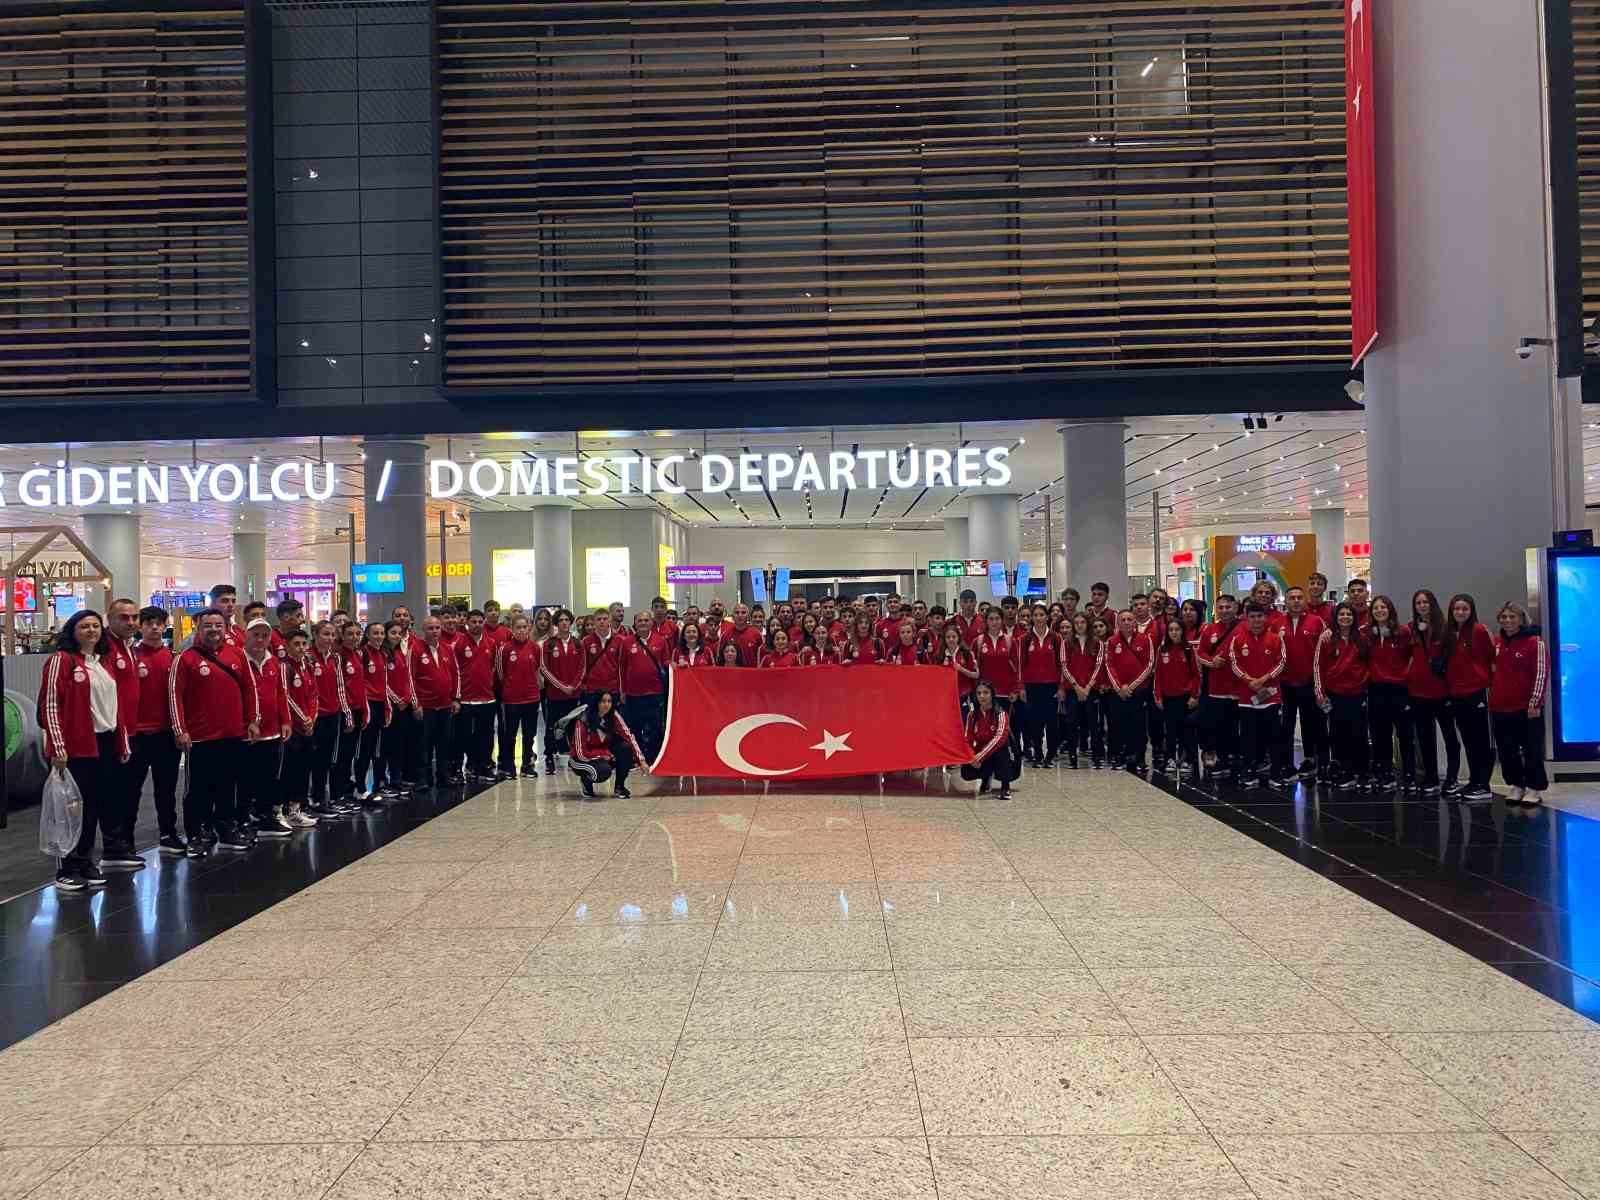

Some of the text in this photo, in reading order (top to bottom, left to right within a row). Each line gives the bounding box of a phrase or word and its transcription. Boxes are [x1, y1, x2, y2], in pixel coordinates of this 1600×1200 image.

[18, 460, 169, 506] GİDEN
[178, 462, 334, 502] YOLCU
[430, 455, 686, 498] DOMESTIC
[701, 446, 1012, 493] DEPARTURES
[1276, 543, 1296, 551] FIRST
